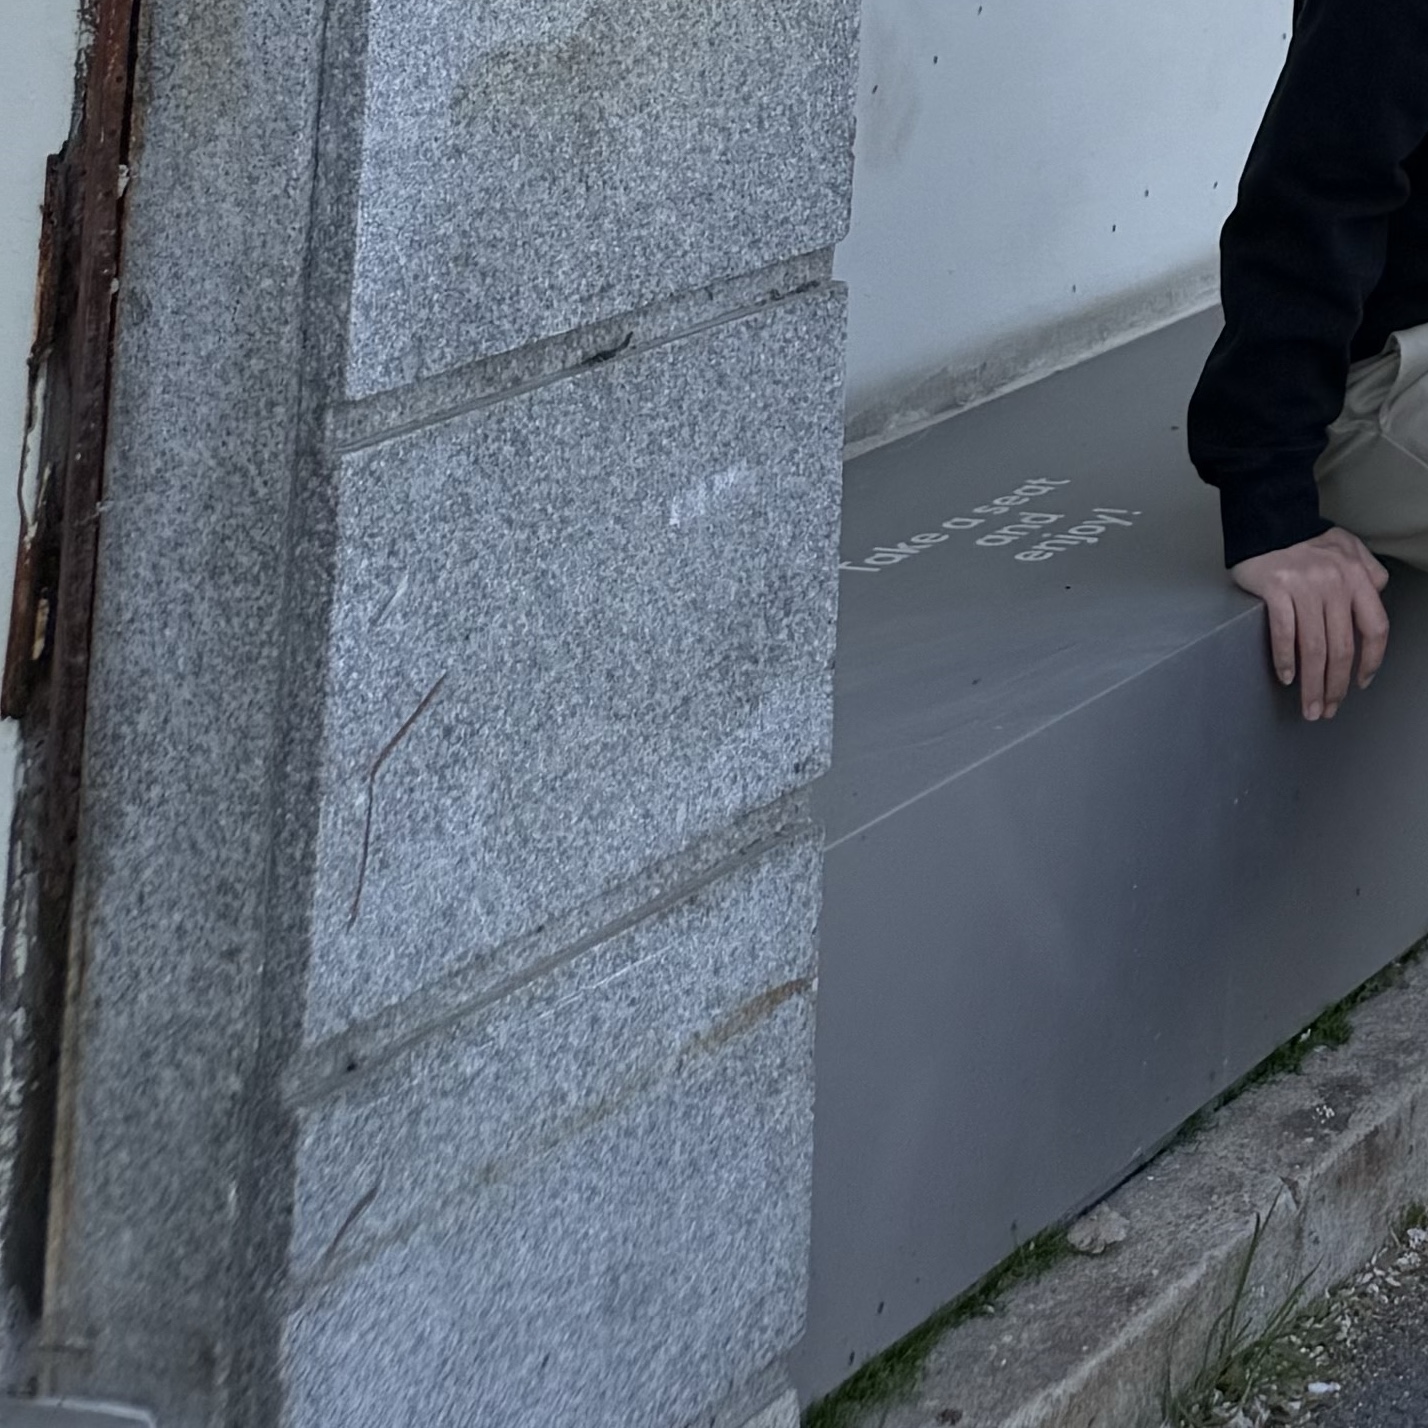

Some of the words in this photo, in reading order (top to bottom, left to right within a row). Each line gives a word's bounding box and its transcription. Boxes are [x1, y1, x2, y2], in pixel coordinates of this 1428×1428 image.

[838, 532, 950, 572] Take
[942, 517, 986, 530] a
[972, 477, 1071, 515] seat
[975, 511, 1066, 547] and
[1014, 507, 1142, 562] enjoy!
